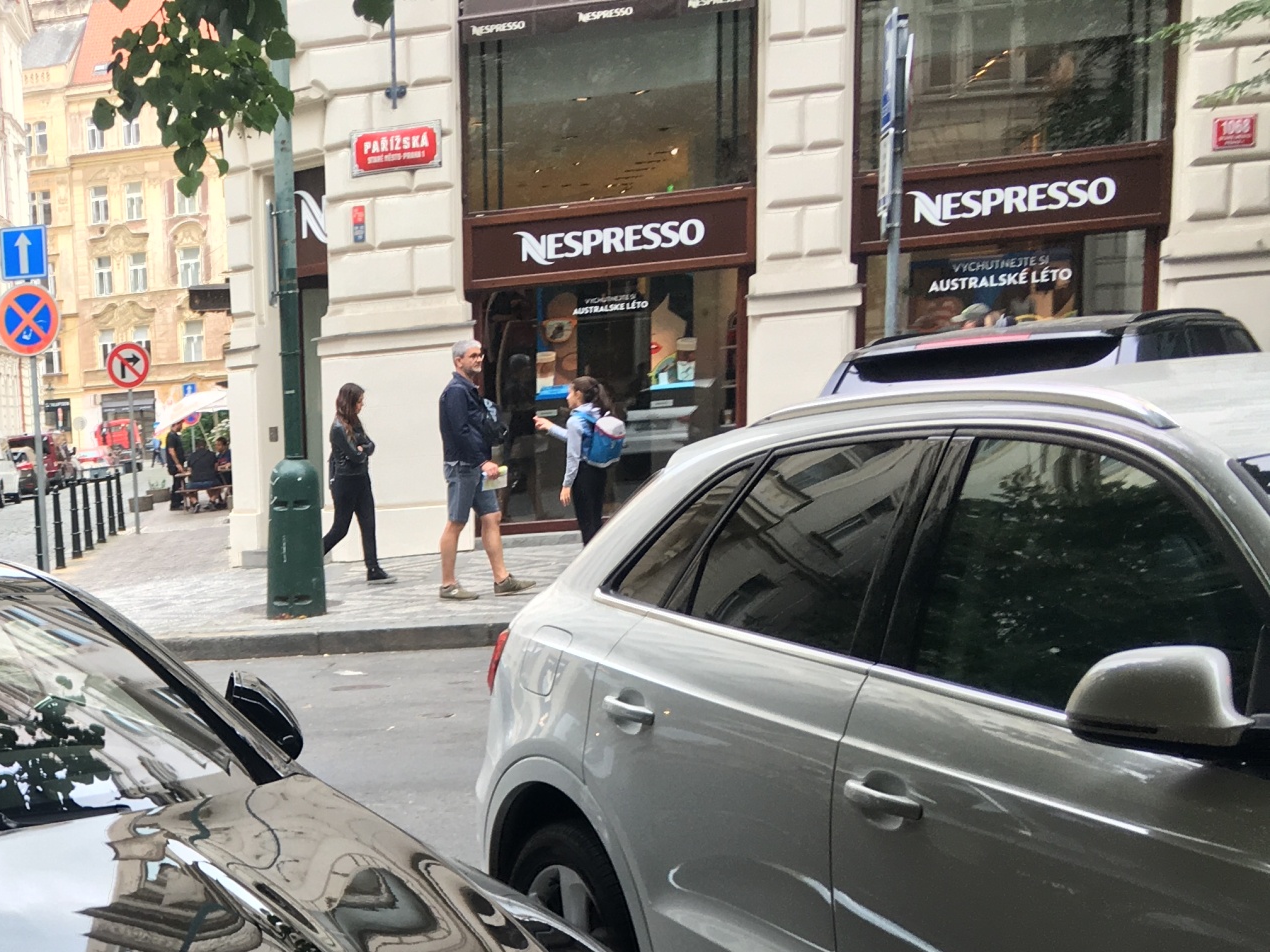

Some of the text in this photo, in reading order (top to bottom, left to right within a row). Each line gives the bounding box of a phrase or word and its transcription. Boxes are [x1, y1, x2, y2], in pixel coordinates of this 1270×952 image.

[578, 6, 634, 22] NESPRESSO
[471, 20, 525, 36] NESPRESSO
[363, 132, 429, 154] PAŘÍŽSKÁ
[907, 177, 1116, 226] NESPRESSO
[514, 218, 705, 266] NESPRESSO
[952, 255, 1050, 273] VYCHUTNEJTE SI
[928, 266, 1072, 293] AUSTRALSKÉ LÉTO
[626, 300, 649, 310] LÉTO
